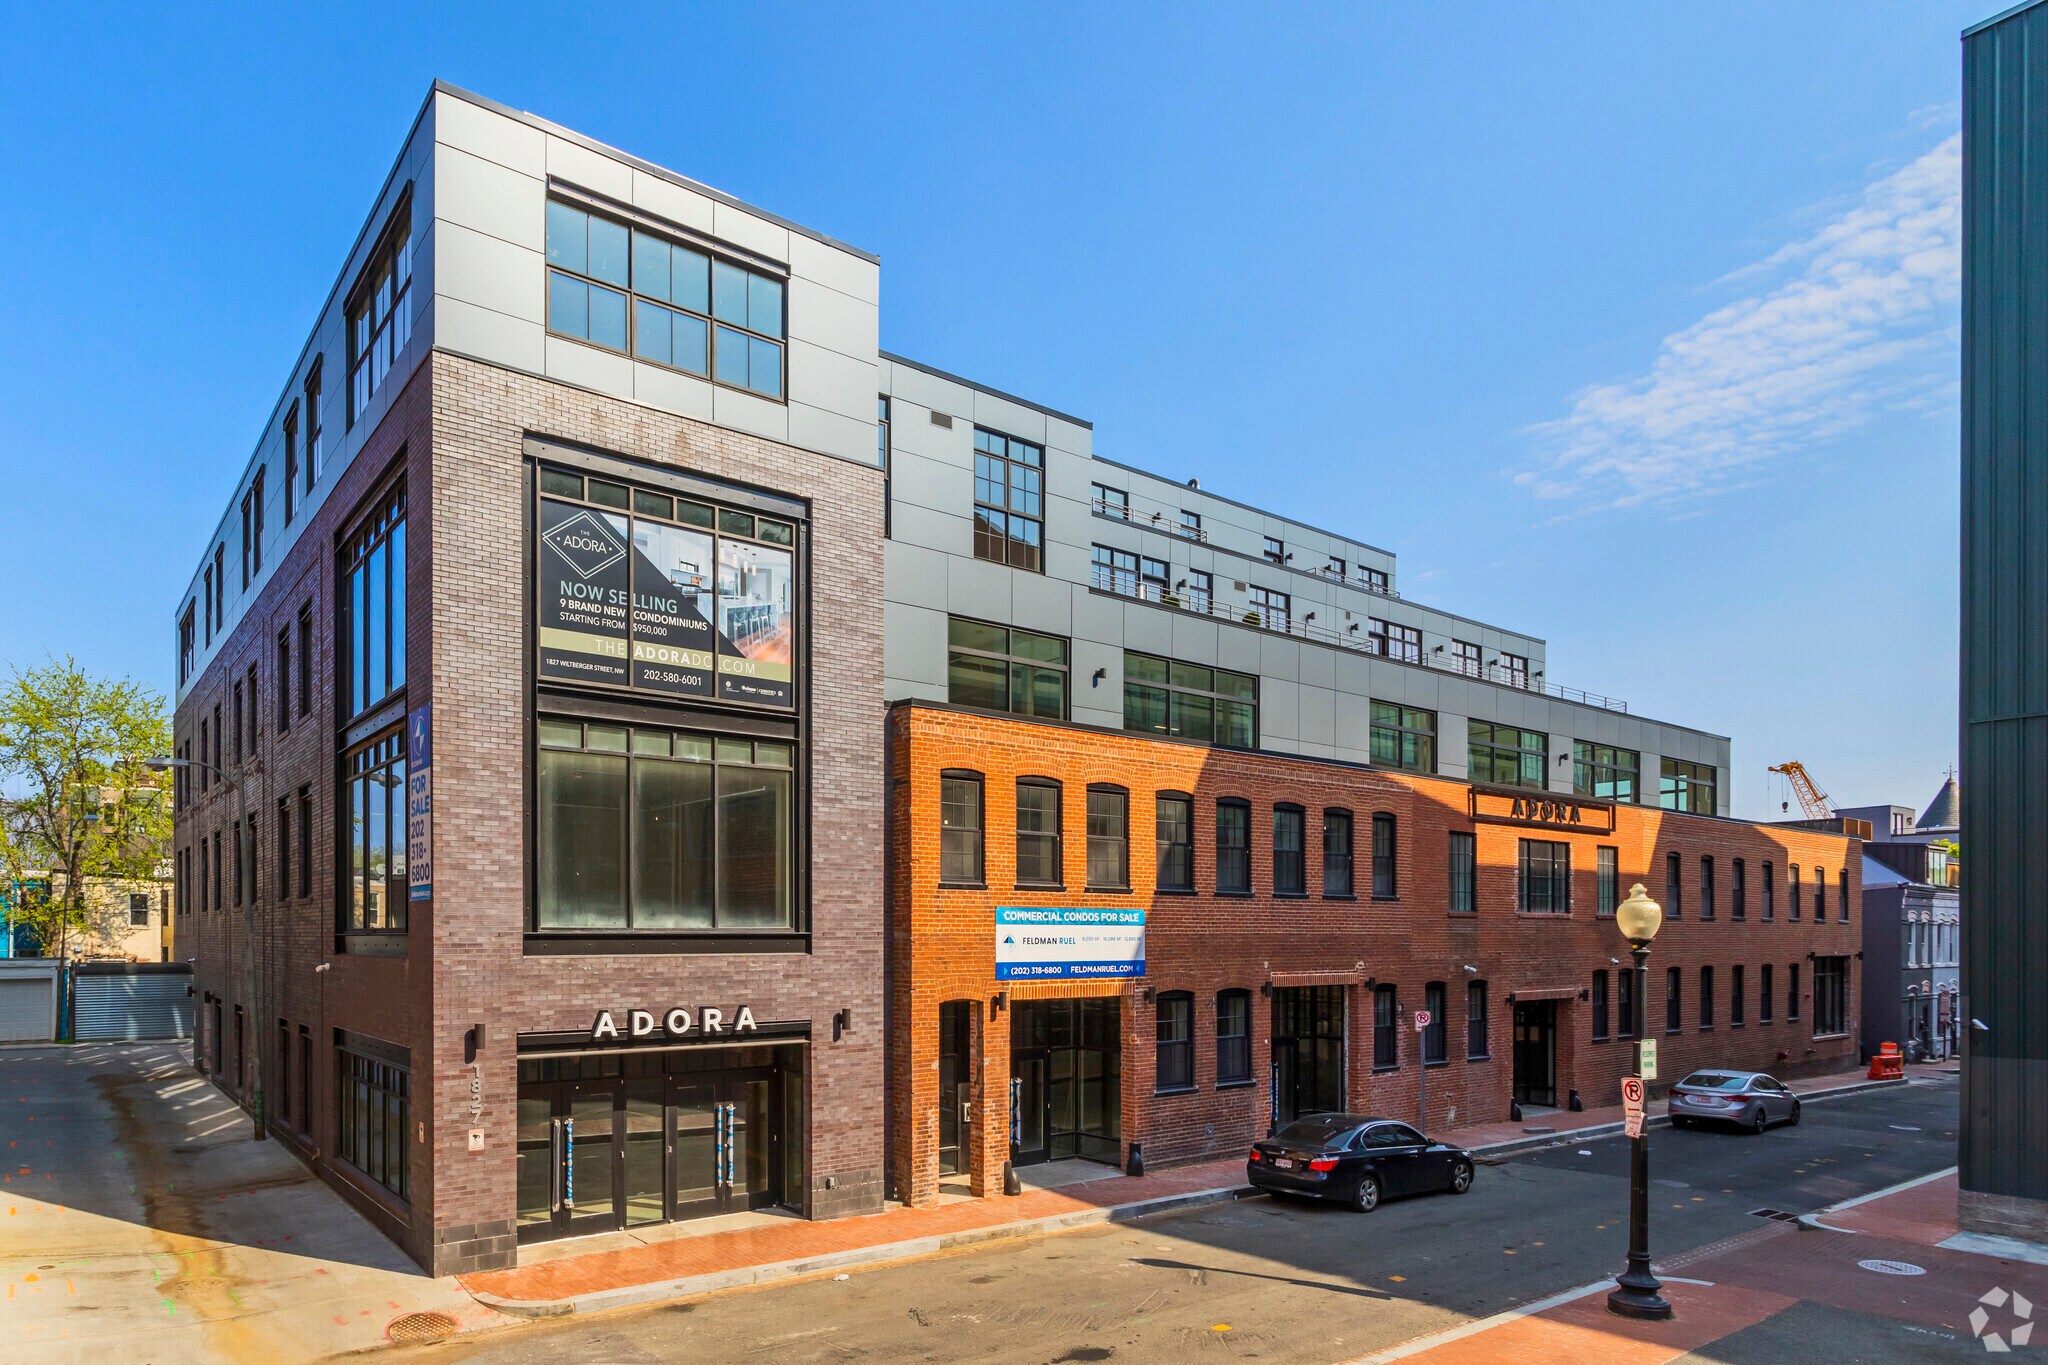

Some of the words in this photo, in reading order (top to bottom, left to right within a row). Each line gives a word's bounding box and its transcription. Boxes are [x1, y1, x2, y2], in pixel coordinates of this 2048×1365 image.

[580, 529, 590, 537] THE
[563, 534, 607, 554] ADORA
[560, 580, 604, 601] NOW
[609, 588, 678, 614] SELLING
[559, 598, 567, 608] 9
[568, 600, 602, 613] BRAND
[603, 605, 626, 618] NEW
[633, 610, 708, 631] CONDOMINIUMS
[559, 611, 600, 626] STARTING
[601, 618, 626, 630] FROM
[632, 622, 668, 636] $950,000
[546, 658, 559, 666] 1827
[560, 660, 594, 672] WILTBERGER
[594, 664, 614, 674] STREET,
[614, 667, 625, 675] NW
[643, 669, 702, 687] 202-580-6001
[411, 774, 426, 796] FOR
[411, 794, 430, 818] SALE
[1511, 796, 1581, 824] ADORA
[411, 819, 425, 840] 202
[411, 841, 427, 861] 318-
[411, 862, 430, 883] 6800
[1003, 911, 1062, 922] COMMERCIAL
[1064, 912, 1099, 922] CONDOS
[1101, 913, 1118, 922] FOR
[1119, 913, 1139, 923] SALE
[1022, 937, 1058, 945] FELDMAN
[1059, 937, 1076, 945] RUEL
[1010, 966, 1030, 976] (202)
[1031, 966, 1062, 975] 318-6800
[1070, 964, 1134, 974] FELDMANRUEL.COM
[594, 1005, 758, 1038] ADORA
[470, 1063, 481, 1125] 1827
